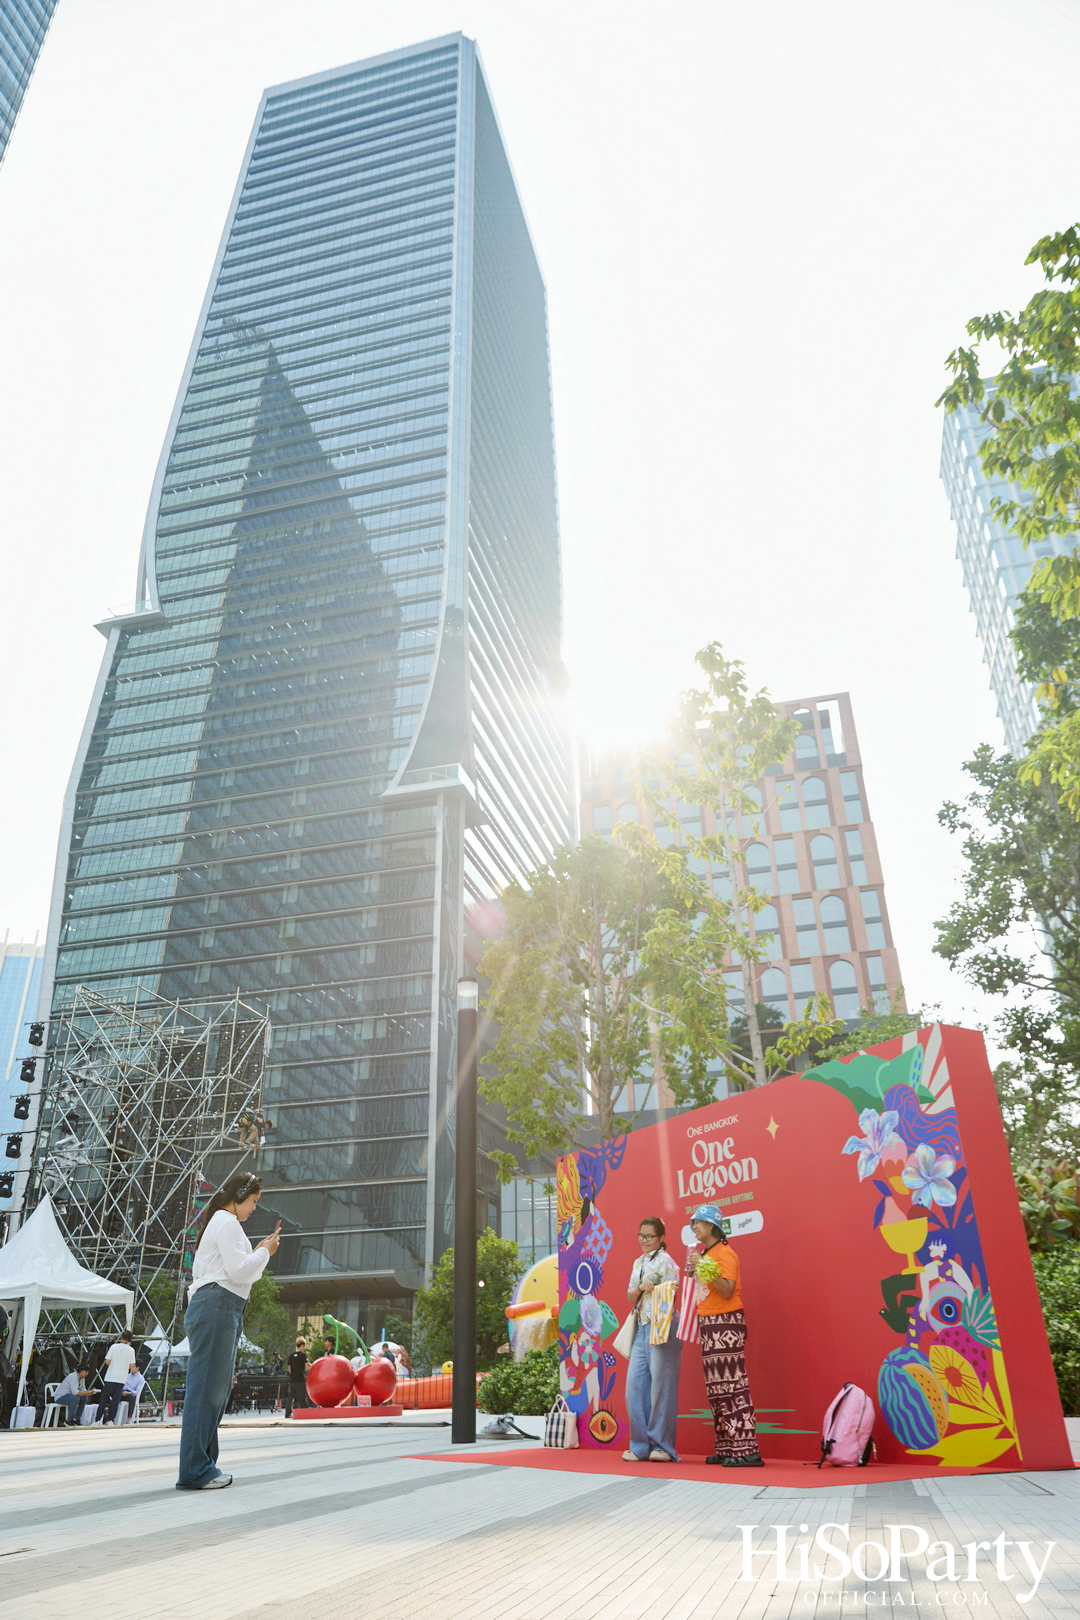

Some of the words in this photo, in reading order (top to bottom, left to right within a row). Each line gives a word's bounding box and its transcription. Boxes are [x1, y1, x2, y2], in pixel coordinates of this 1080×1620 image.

[687, 1127, 703, 1138] ONE
[704, 1114, 739, 1132] BANGKOK
[692, 1137, 735, 1168] One
[677, 1156, 759, 1198] Lagoon
[732, 1191, 754, 1204] RHYTHMS
